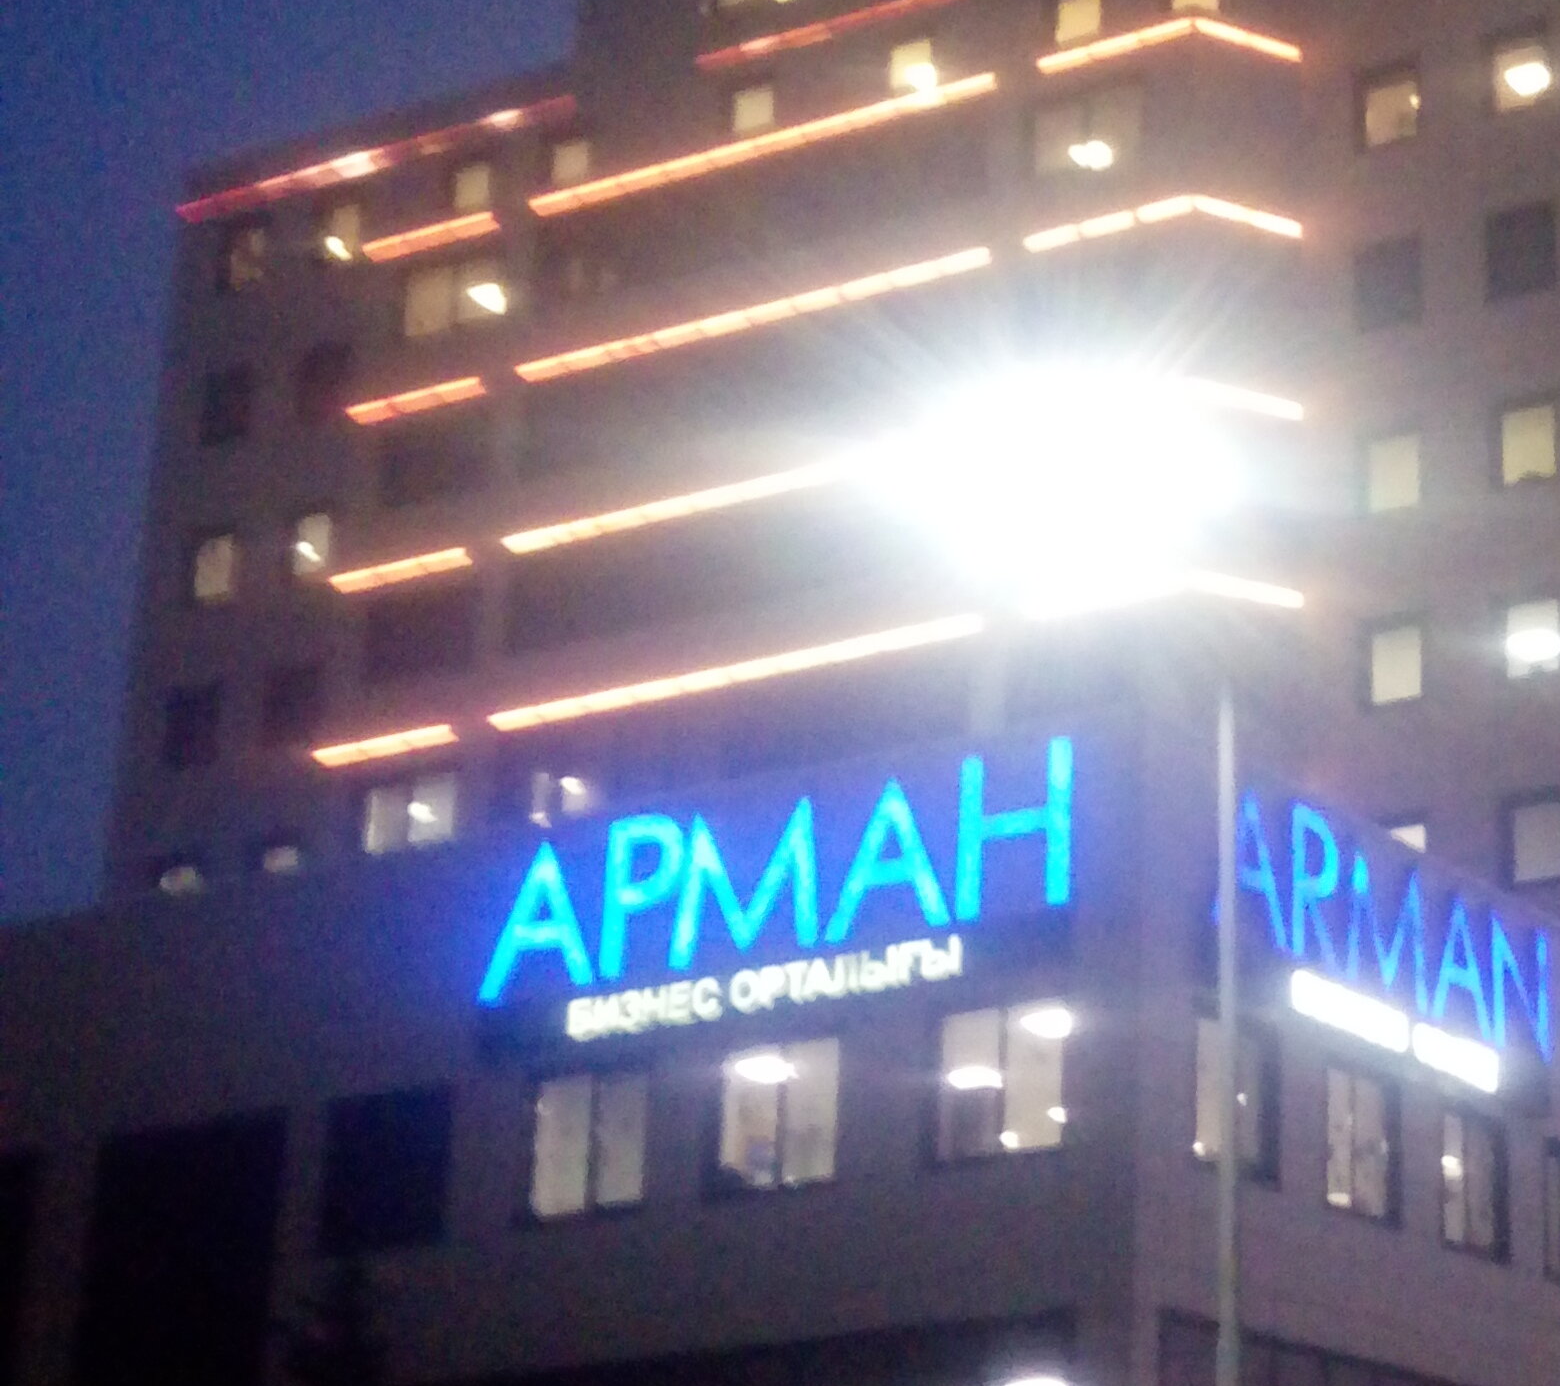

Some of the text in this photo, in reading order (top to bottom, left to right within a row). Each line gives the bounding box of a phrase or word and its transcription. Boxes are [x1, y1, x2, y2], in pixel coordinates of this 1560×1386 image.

[478, 735, 1074, 1007] АРМАН
[1212, 789, 1552, 1065] ARMAN
[564, 976, 723, 1043] БИЗНЕС
